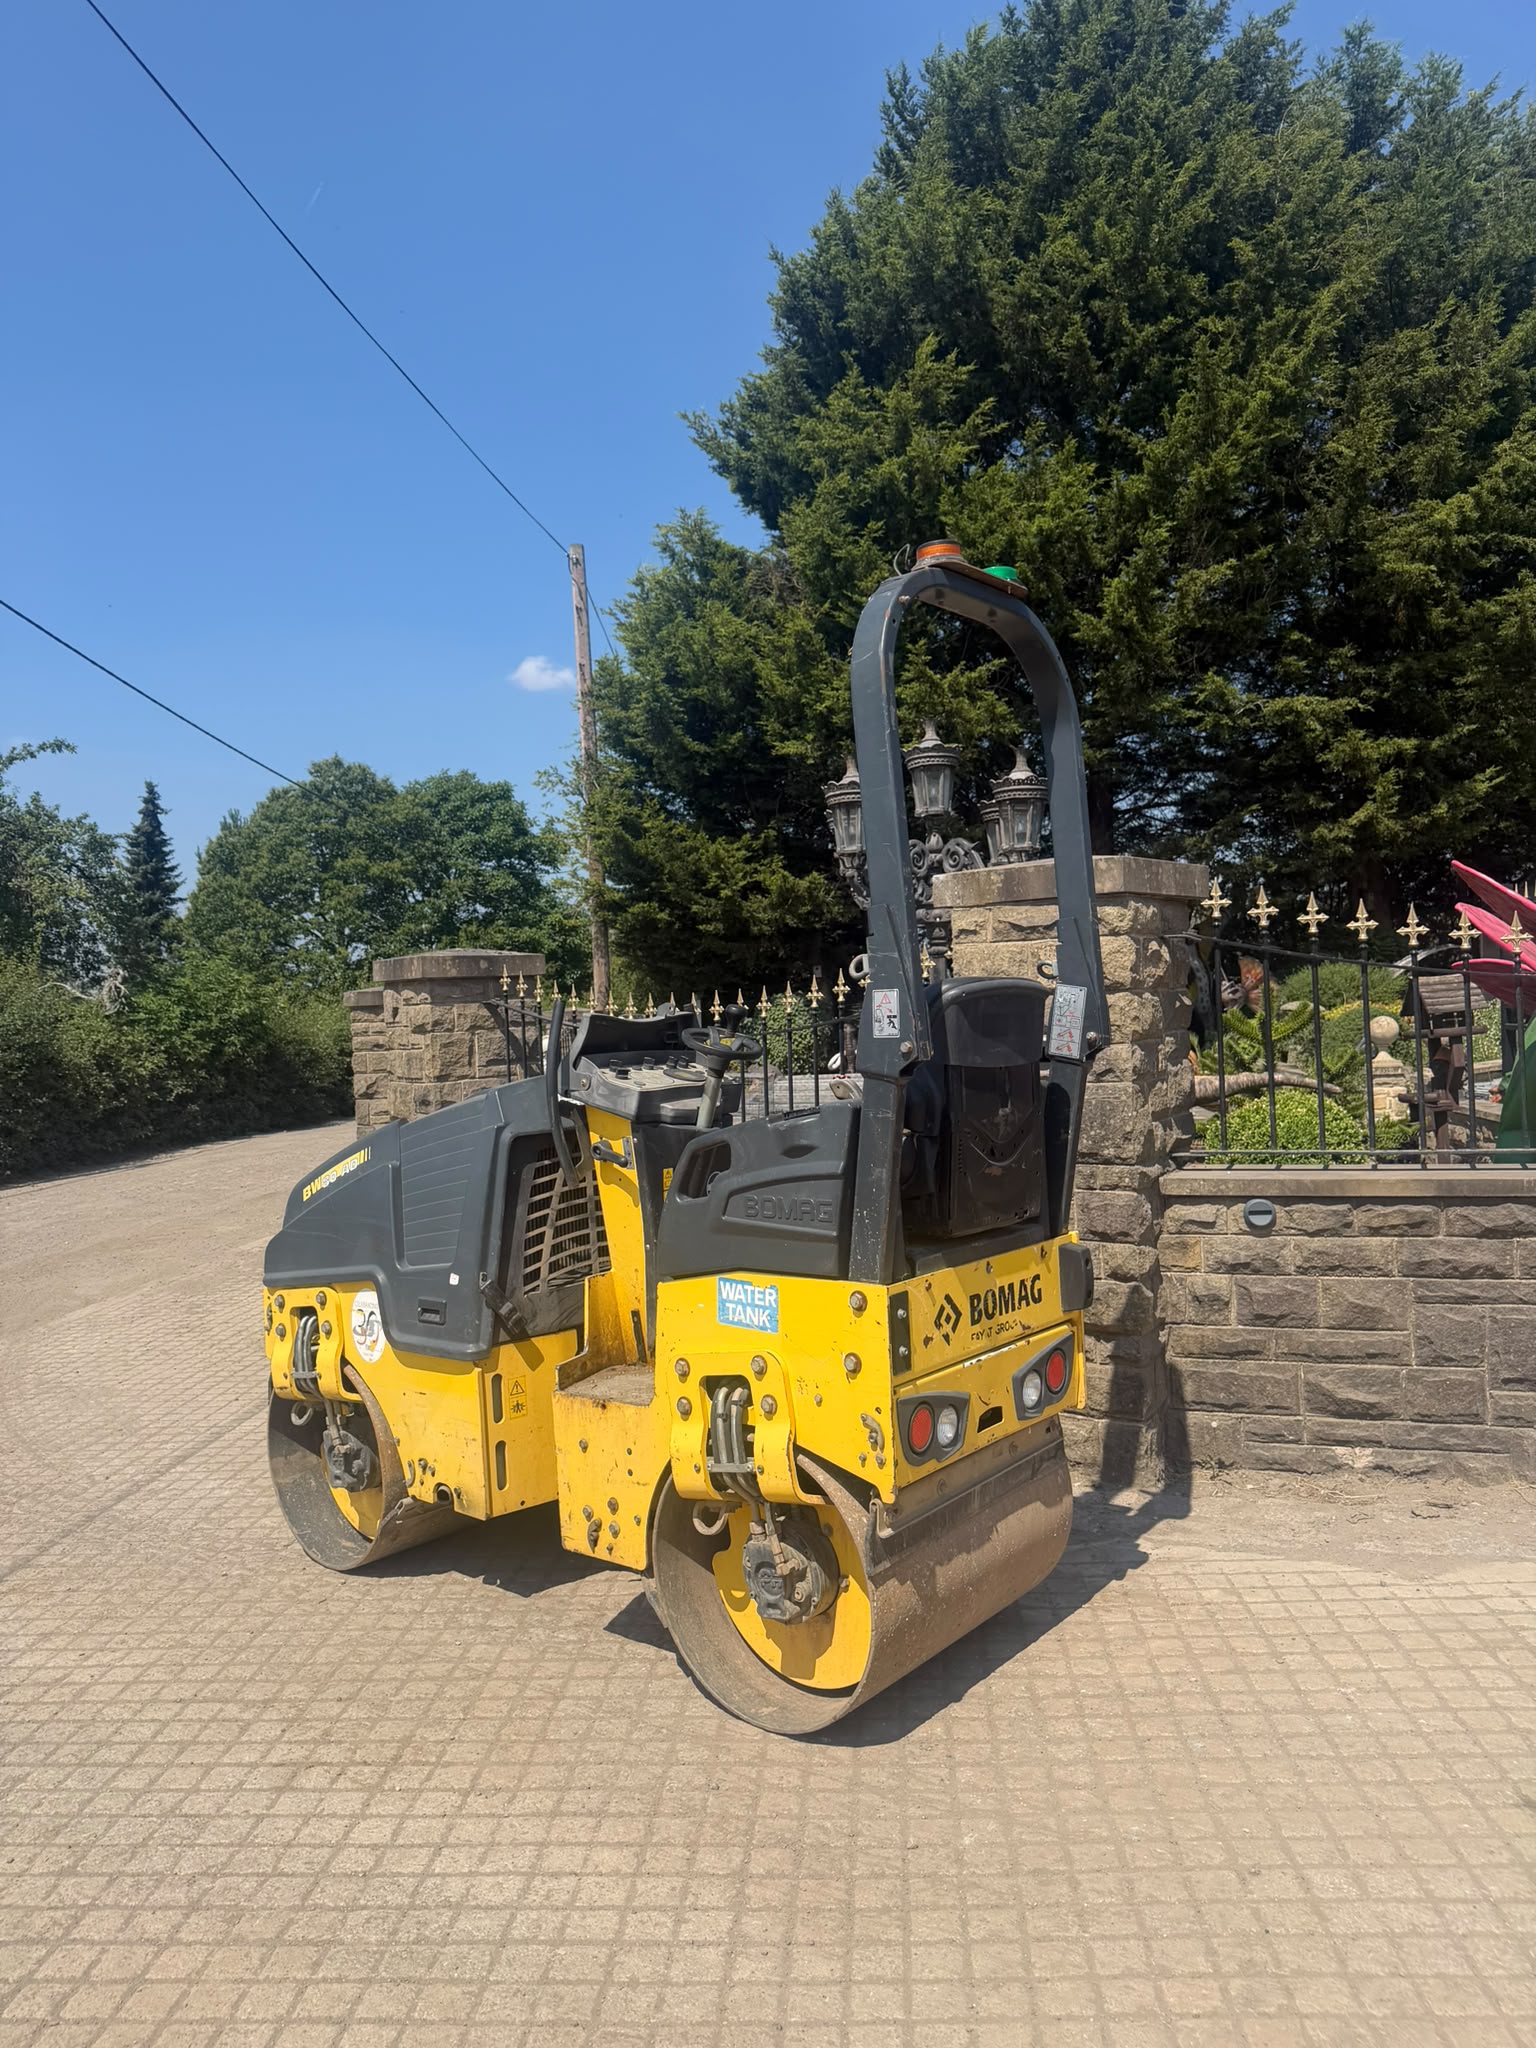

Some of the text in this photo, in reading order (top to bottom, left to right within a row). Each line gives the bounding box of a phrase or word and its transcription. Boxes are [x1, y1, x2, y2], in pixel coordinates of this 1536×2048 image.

[719, 1280, 777, 1308] WATER
[969, 1273, 1042, 1326] BOMAG
[725, 1302, 771, 1329] TANK
